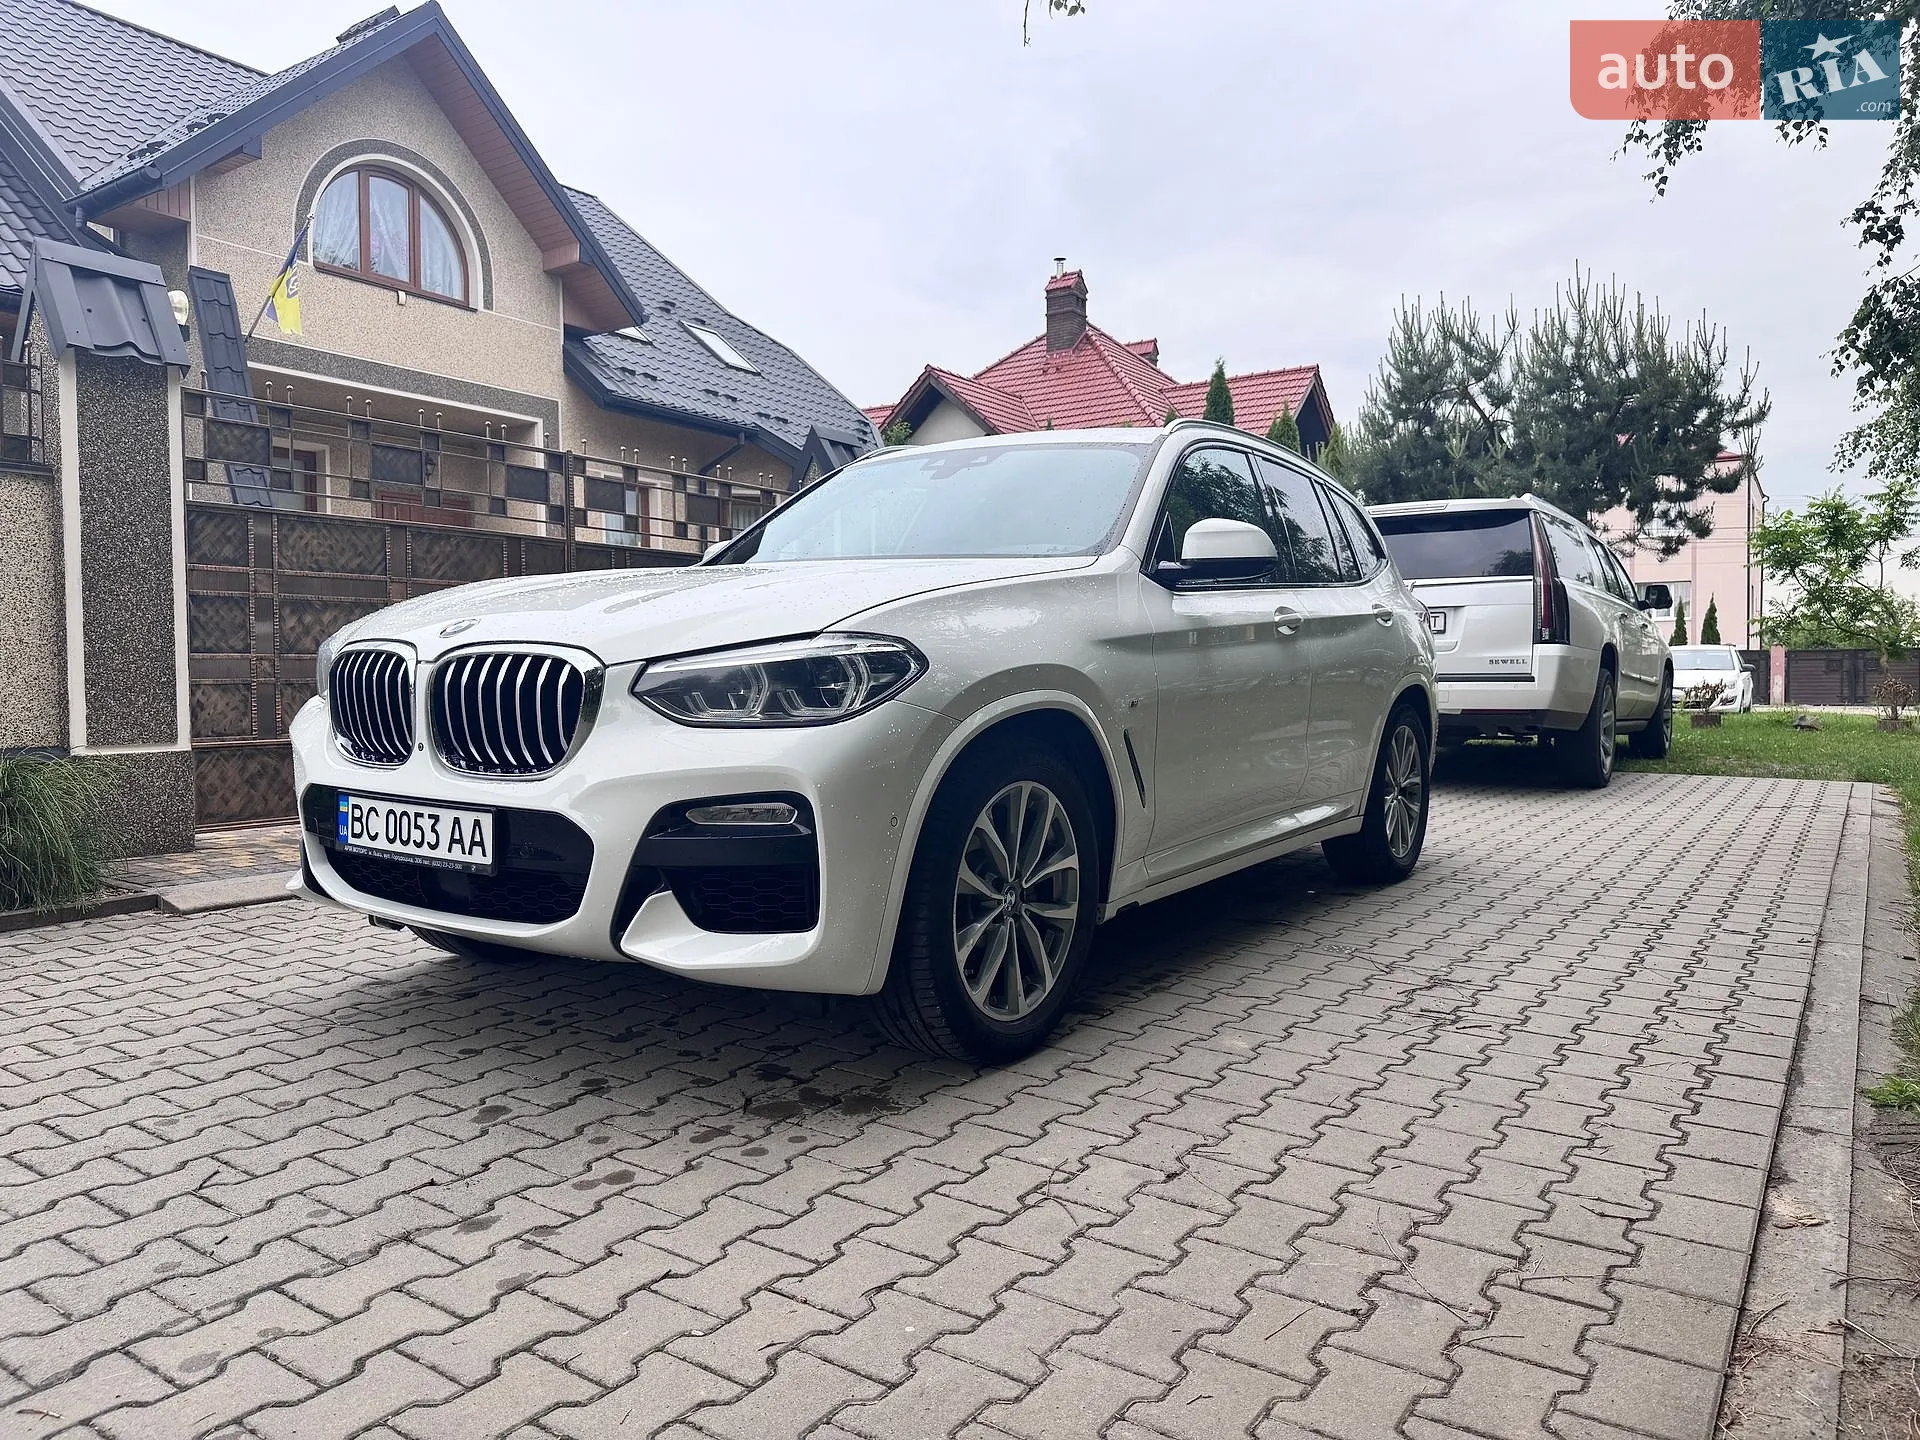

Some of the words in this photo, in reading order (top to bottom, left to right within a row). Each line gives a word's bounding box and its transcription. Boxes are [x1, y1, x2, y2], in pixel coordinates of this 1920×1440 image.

[339, 825, 348, 837] UA
[351, 803, 380, 842] BC
[385, 808, 440, 851] 0053
[447, 816, 487, 858] AA
